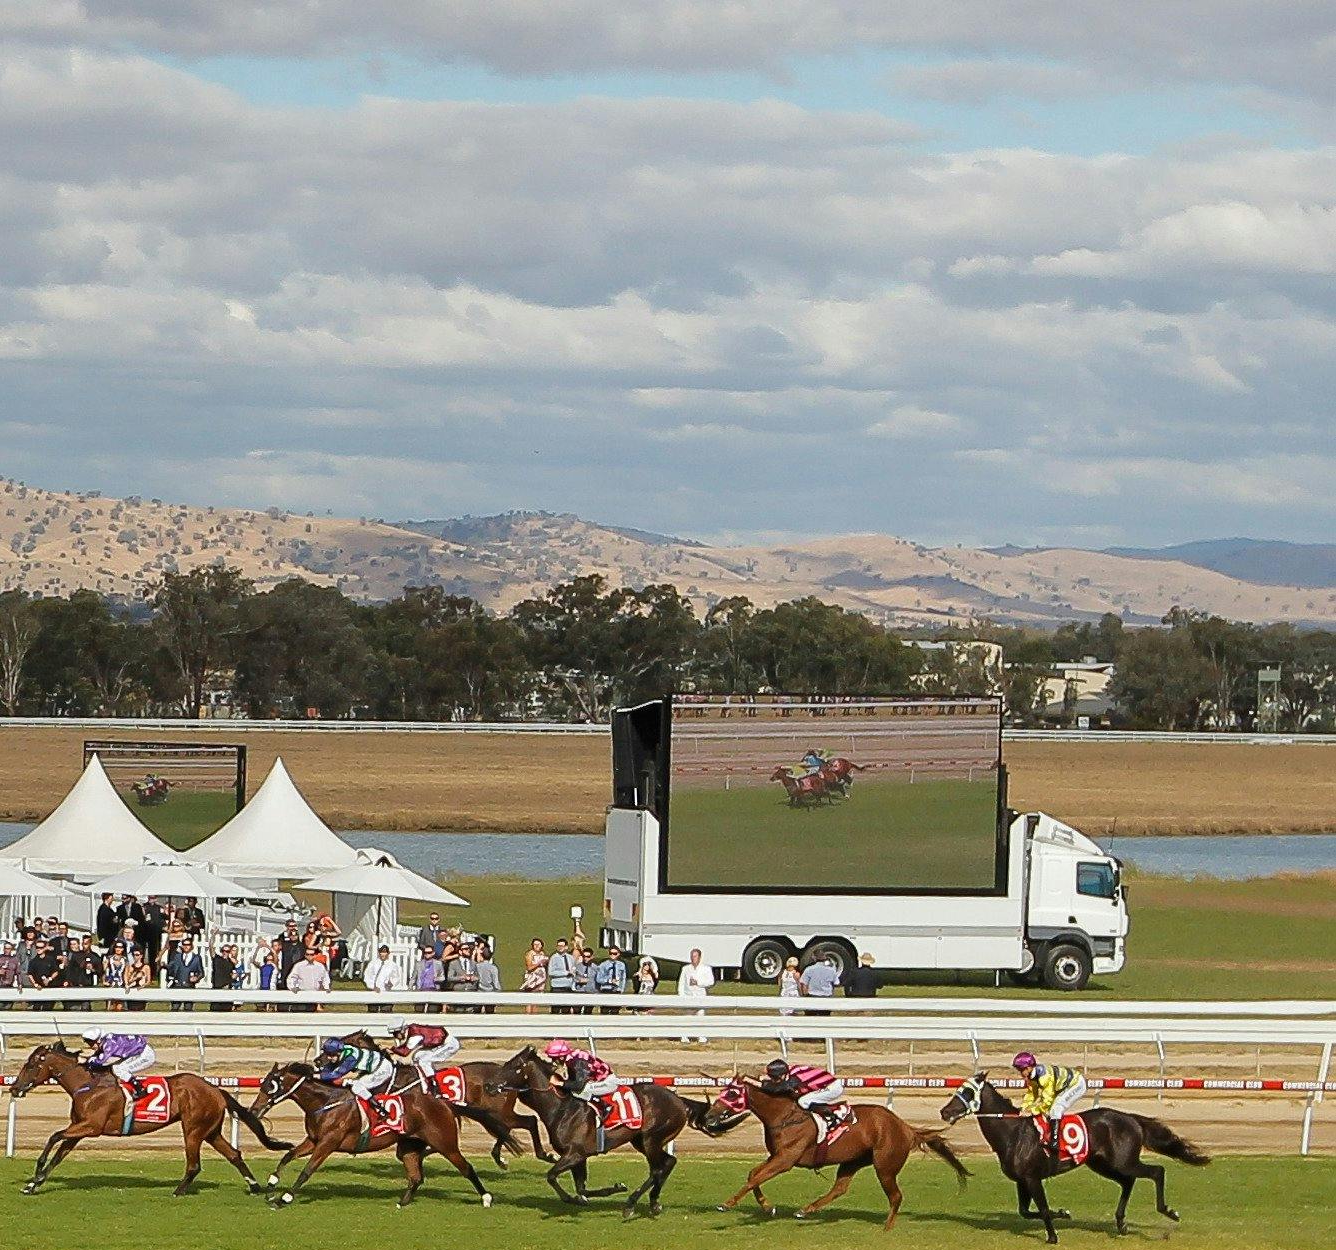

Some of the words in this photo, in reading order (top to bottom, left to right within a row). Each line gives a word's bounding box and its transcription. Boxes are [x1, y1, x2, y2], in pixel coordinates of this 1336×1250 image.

[146, 1083, 166, 1112] 2
[442, 1075, 462, 1102] 3
[612, 1091, 641, 1120] 11
[1063, 1122, 1085, 1155] 9
